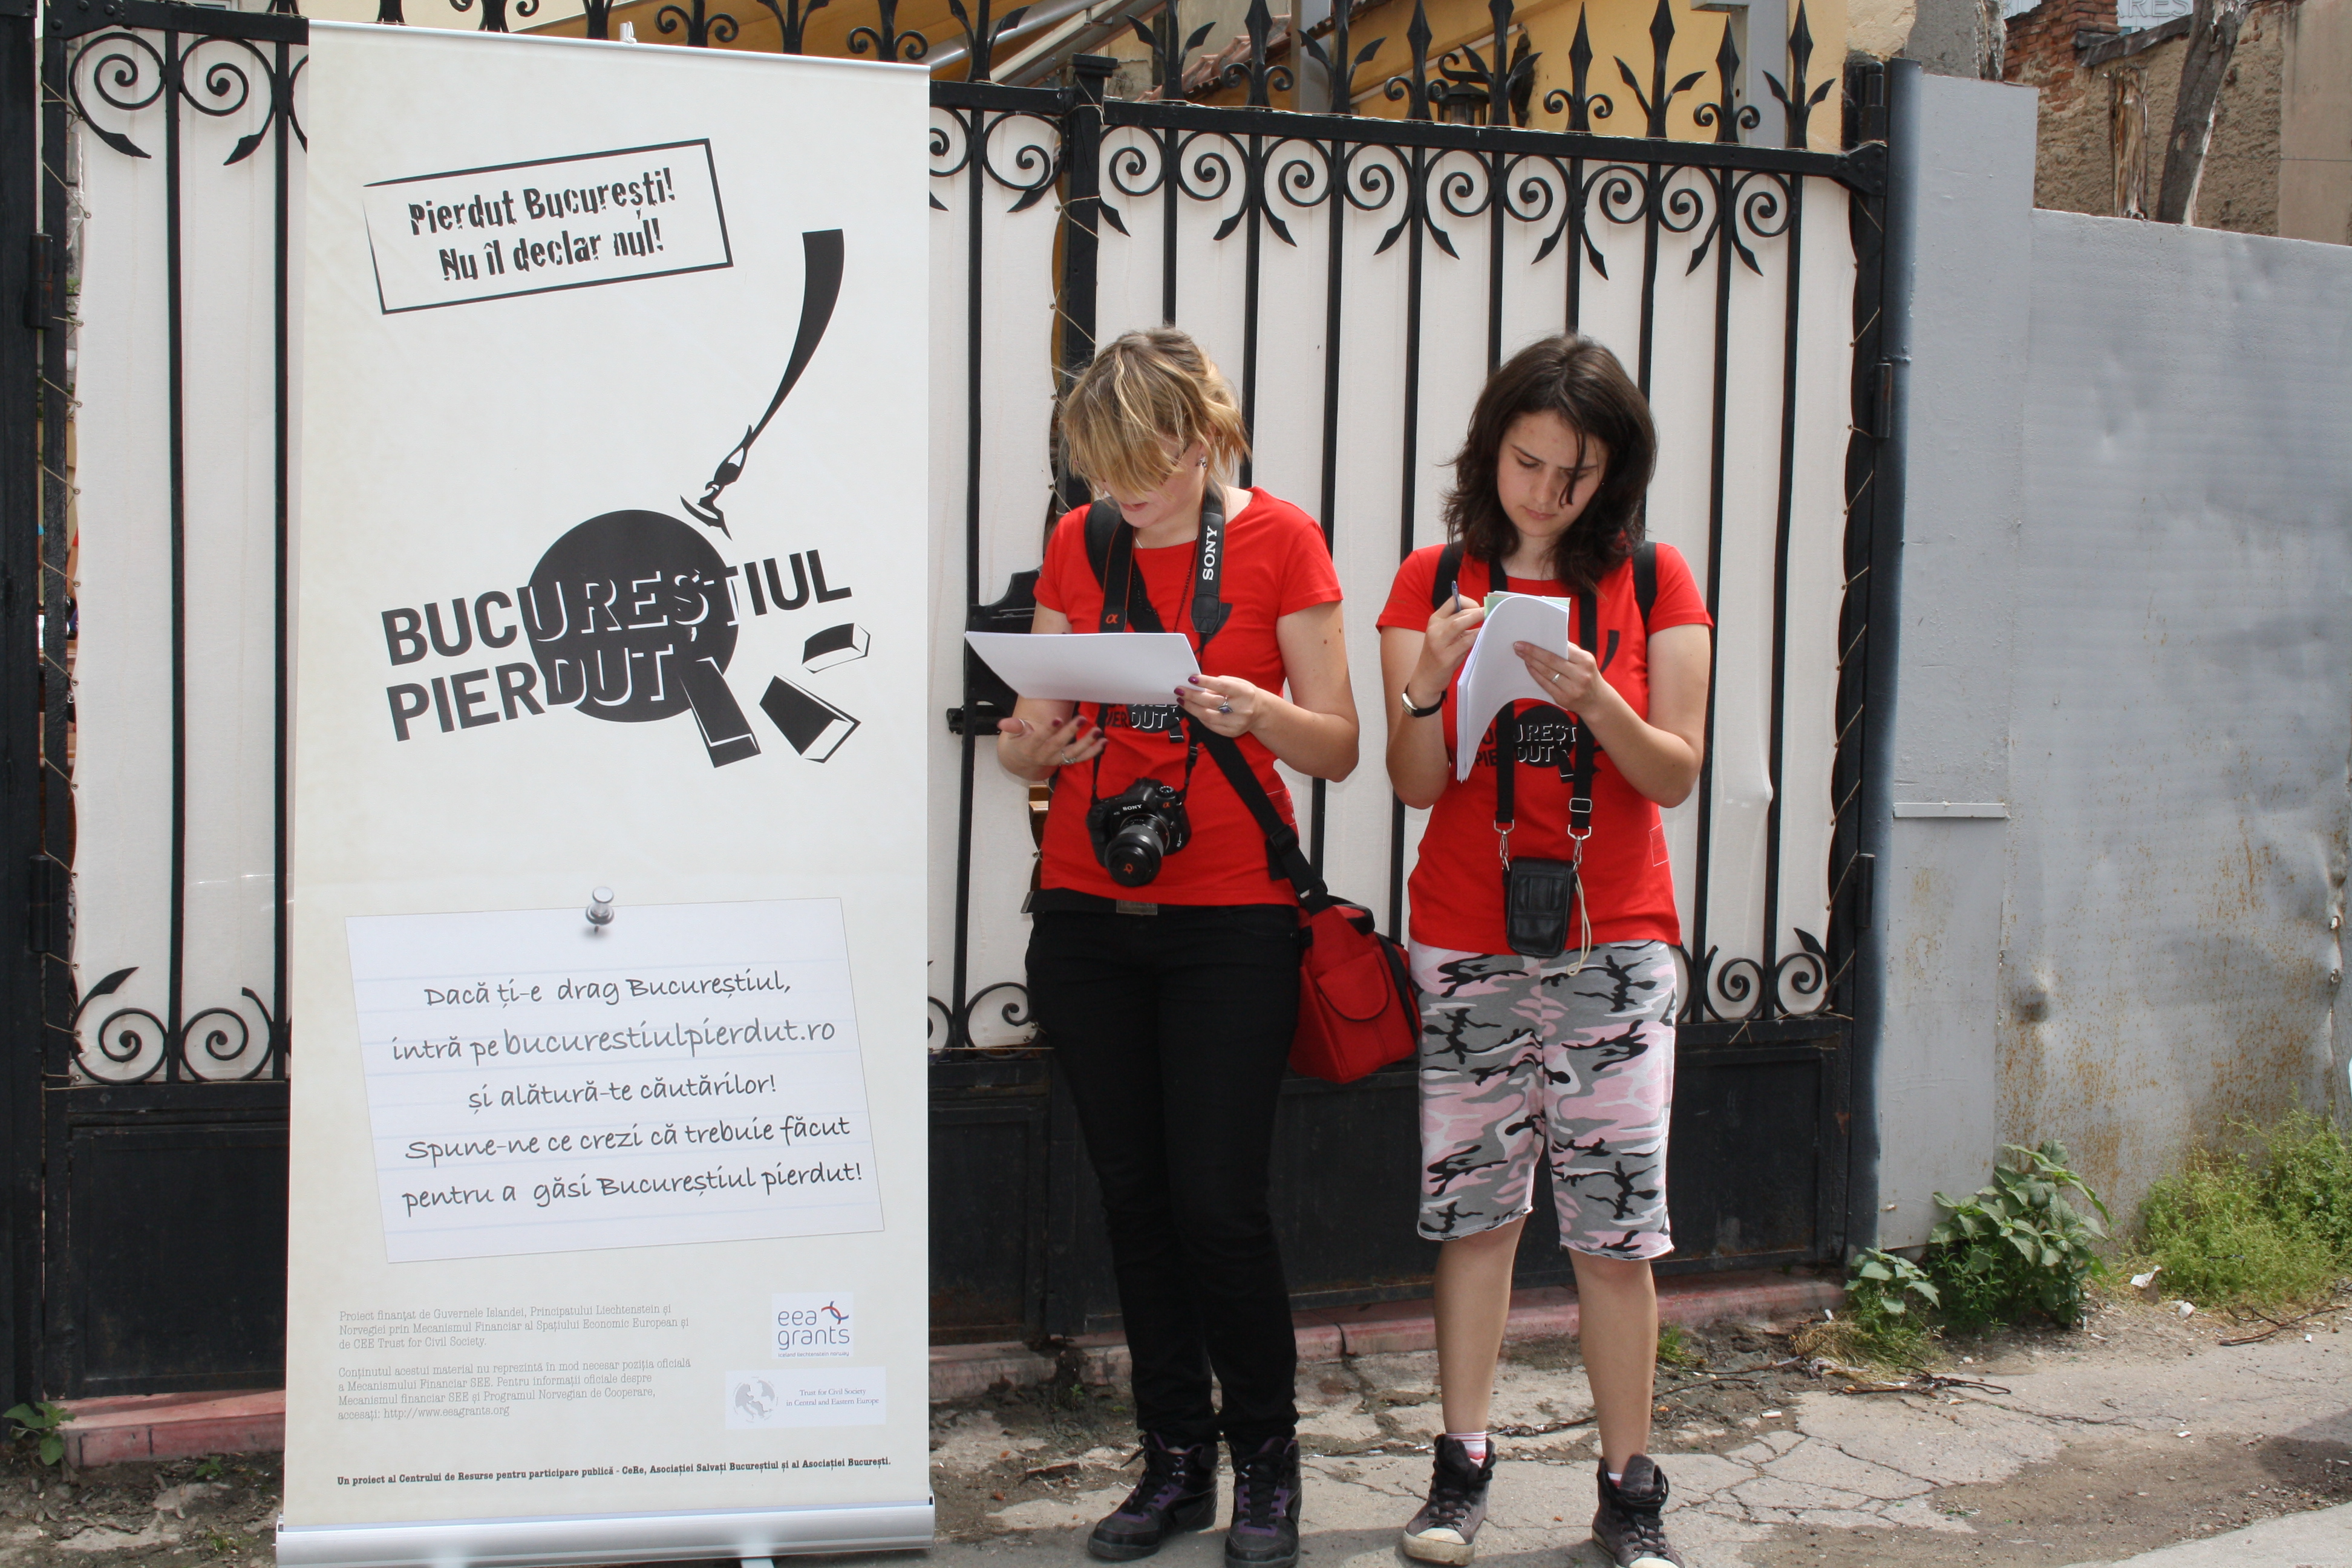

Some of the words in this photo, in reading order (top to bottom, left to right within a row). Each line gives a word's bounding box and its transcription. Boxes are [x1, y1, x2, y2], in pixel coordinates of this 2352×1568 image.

[408, 191, 517, 235] Pierdut
[524, 167, 675, 220] București!
[439, 248, 478, 281] Nu
[483, 240, 505, 275] îl
[514, 230, 601, 272] declar
[613, 218, 664, 257] nul!
[1202, 525, 1217, 581] SONY
[385, 643, 675, 742] PIERDUT
[425, 982, 491, 1006] Dacă
[497, 979, 543, 1010] ți-e
[557, 978, 619, 1005] drag
[626, 969, 791, 999] Bucureștiul,
[392, 1036, 462, 1060] intră
[470, 1039, 499, 1066] pe
[503, 1018, 835, 1058] bucurestiulpierdut.ro
[468, 1085, 492, 1114] și
[501, 1079, 633, 1107] alătură-te
[640, 1072, 776, 1099] căutărilor!
[405, 1137, 540, 1168] Spune-ne
[547, 1134, 573, 1153] ce
[580, 1122, 643, 1150] crezi
[650, 1123, 678, 1145] că
[685, 1114, 774, 1144] trebuie
[780, 1114, 850, 1147] făcut
[402, 1184, 494, 1217] pentru
[503, 1184, 516, 1203] a
[534, 1174, 592, 1207] găsi
[596, 1165, 756, 1198] Bucureștiul
[760, 1163, 861, 1196] pierdut!
[340, 1311, 374, 1321] Proiect
[419, 1310, 430, 1319] de
[434, 1308, 483, 1318] Guvernele
[486, 1307, 526, 1318] Islandei,
[531, 1305, 592, 1318] Principatului
[596, 1304, 660, 1315] Liechtenstein
[777, 1310, 817, 1326] eea
[339, 1325, 386, 1336] Norvegiei
[388, 1324, 410, 1336] prin
[413, 1322, 471, 1333] Mecanismul
[475, 1322, 521, 1331] Financiar
[525, 1321, 533, 1330] al
[583, 1319, 629, 1328] Economic
[633, 1318, 678, 1329] European
[777, 1325, 850, 1350] grants
[339, 1339, 350, 1349] de
[354, 1338, 374, 1348] CEE
[378, 1338, 405, 1348] Trust
[408, 1337, 422, 1347] for
[425, 1336, 446, 1347] Civil
[450, 1336, 486, 1347] Society.
[395, 1365, 430, 1376] acestui
[433, 1364, 473, 1374] material
[559, 1361, 579, 1371] mod
[348, 1380, 416, 1391] Mecanismului
[420, 1379, 467, 1390] Financiar
[471, 1377, 492, 1387] SEE.
[497, 1377, 529, 1387] Pentru
[584, 1374, 617, 1384] oficiale
[621, 1375, 652, 1385] despre
[844, 1388, 866, 1396] Society
[339, 1394, 397, 1405] Mecanismul
[401, 1394, 445, 1403] financiar
[449, 1392, 468, 1402] SEE
[484, 1391, 535, 1403] Programul
[539, 1390, 587, 1400] Norvegian
[590, 1389, 601, 1397] de
[605, 1389, 655, 1399] Cooperare,
[856, 1397, 880, 1406] Europe
[384, 1406, 509, 1420] http://www.eeagrants.org
[337, 1477, 350, 1485] Un
[352, 1475, 385, 1486] proiect
[388, 1475, 396, 1483] al
[399, 1472, 442, 1483] Centrului
[445, 1472, 455, 1481] de
[496, 1471, 526, 1481] pentru
[529, 1468, 578, 1480] participare
[581, 1466, 613, 1478] publică
[622, 1466, 647, 1475] CeRe,
[650, 1463, 694, 1476] Asociației
[697, 1463, 727, 1474] Salvați
[730, 1461, 779, 1473] Bucureștiul
[782, 1460, 789, 1472] și
[802, 1458, 845, 1471] Asociației
[848, 1457, 890, 1469] București.
